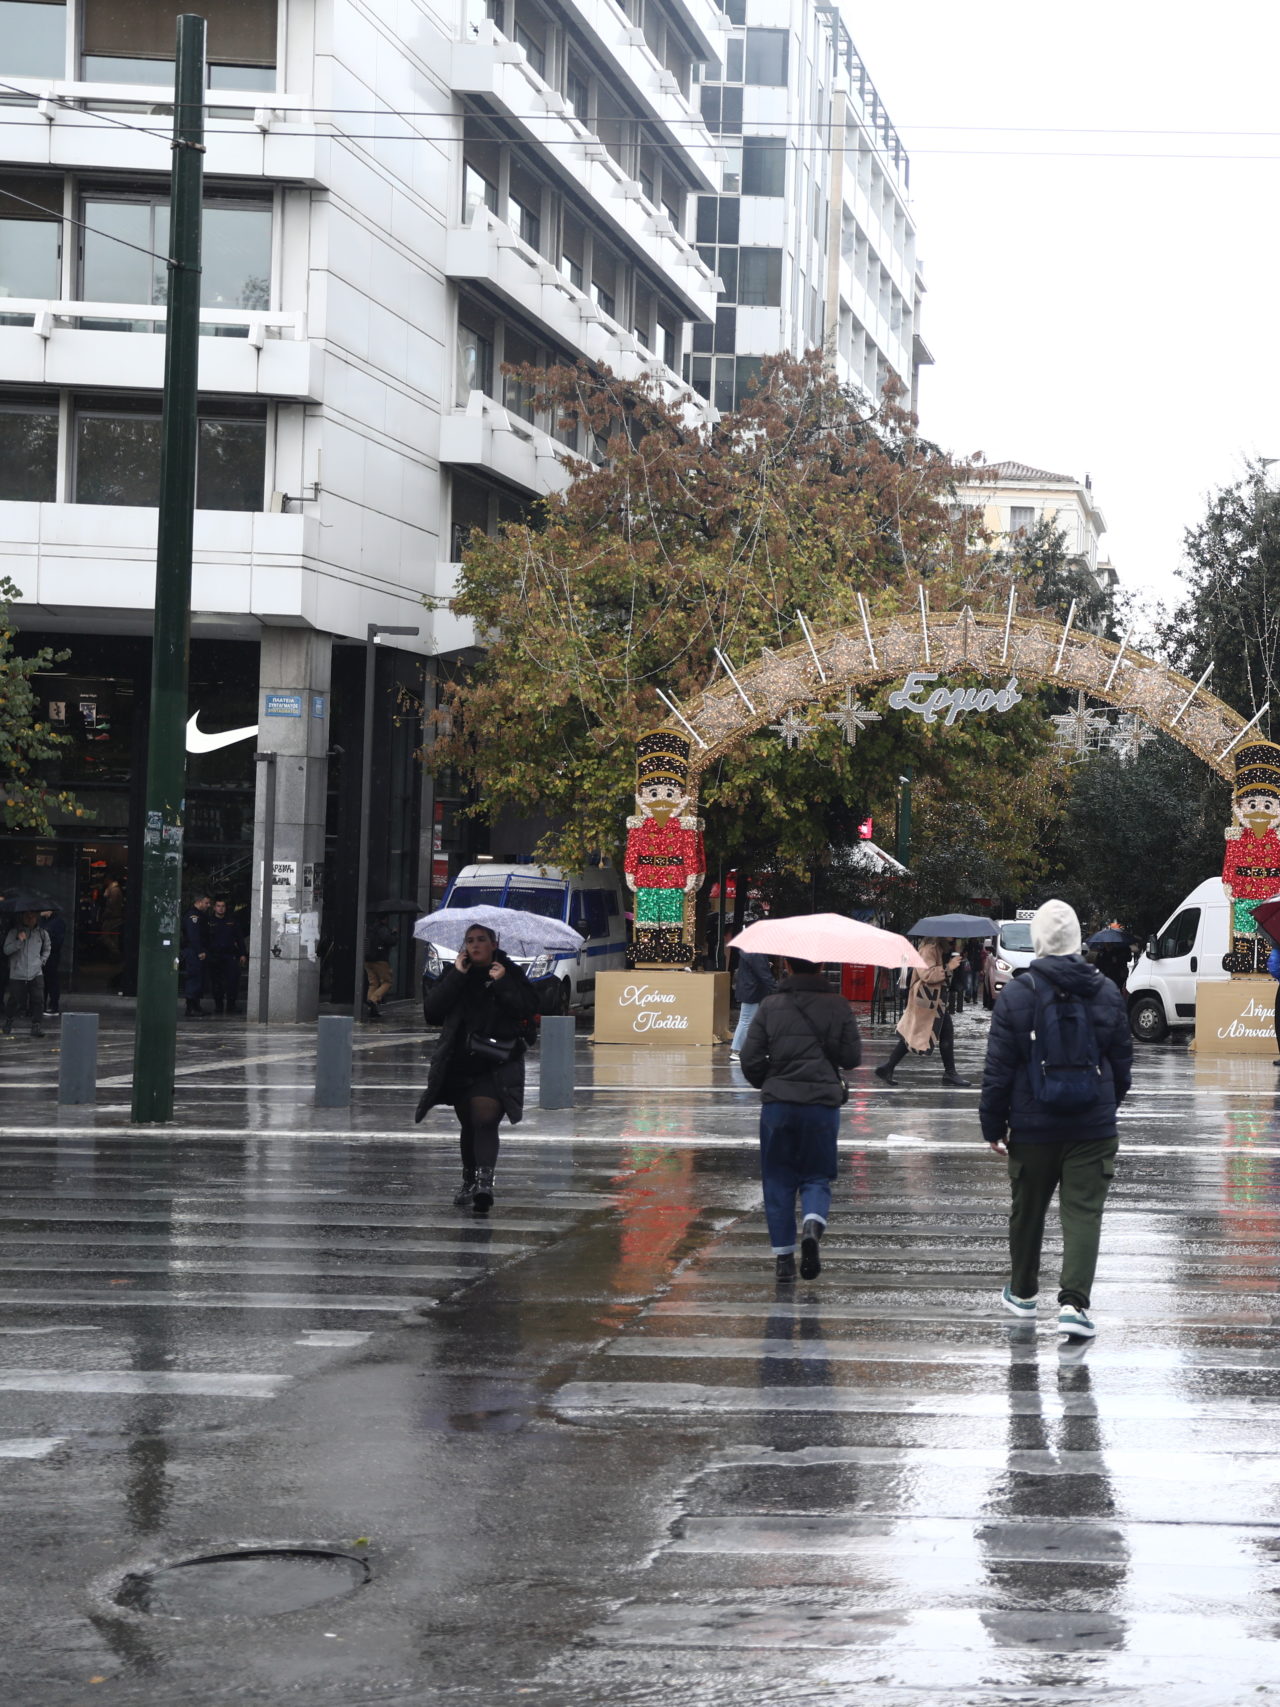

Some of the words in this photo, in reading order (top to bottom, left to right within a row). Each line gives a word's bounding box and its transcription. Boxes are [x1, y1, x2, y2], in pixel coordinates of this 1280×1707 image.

[888, 671, 1023, 727] Ερμού
[618, 984, 676, 1007] Χρόνια
[632, 1010, 689, 1033] Πολλά
